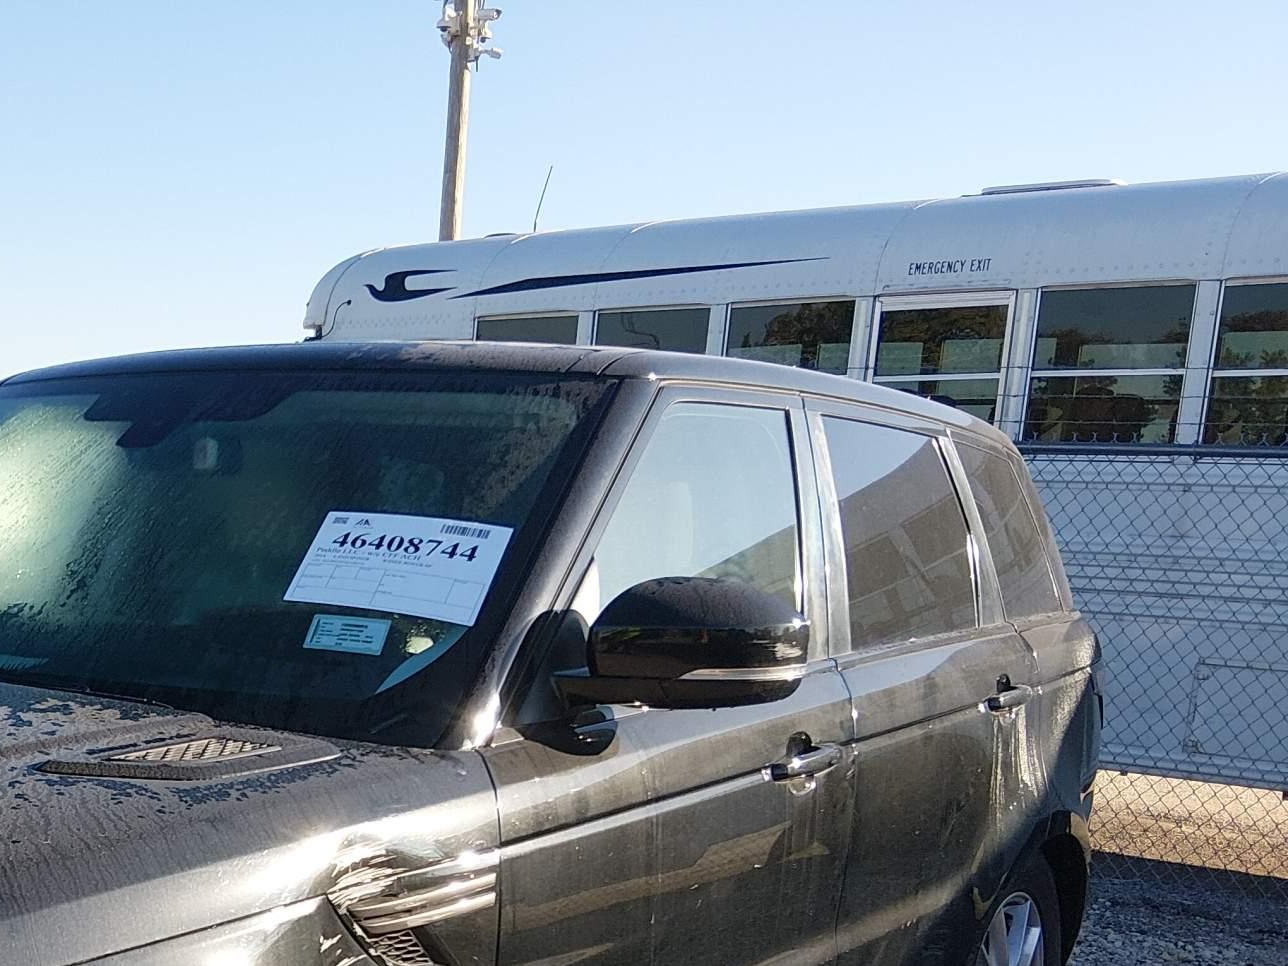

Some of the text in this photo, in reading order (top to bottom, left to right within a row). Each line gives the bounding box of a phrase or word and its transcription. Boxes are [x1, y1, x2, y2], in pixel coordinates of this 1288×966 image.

[908, 258, 992, 276] EMERGENCY EXIT
[331, 531, 479, 562] 46408744
